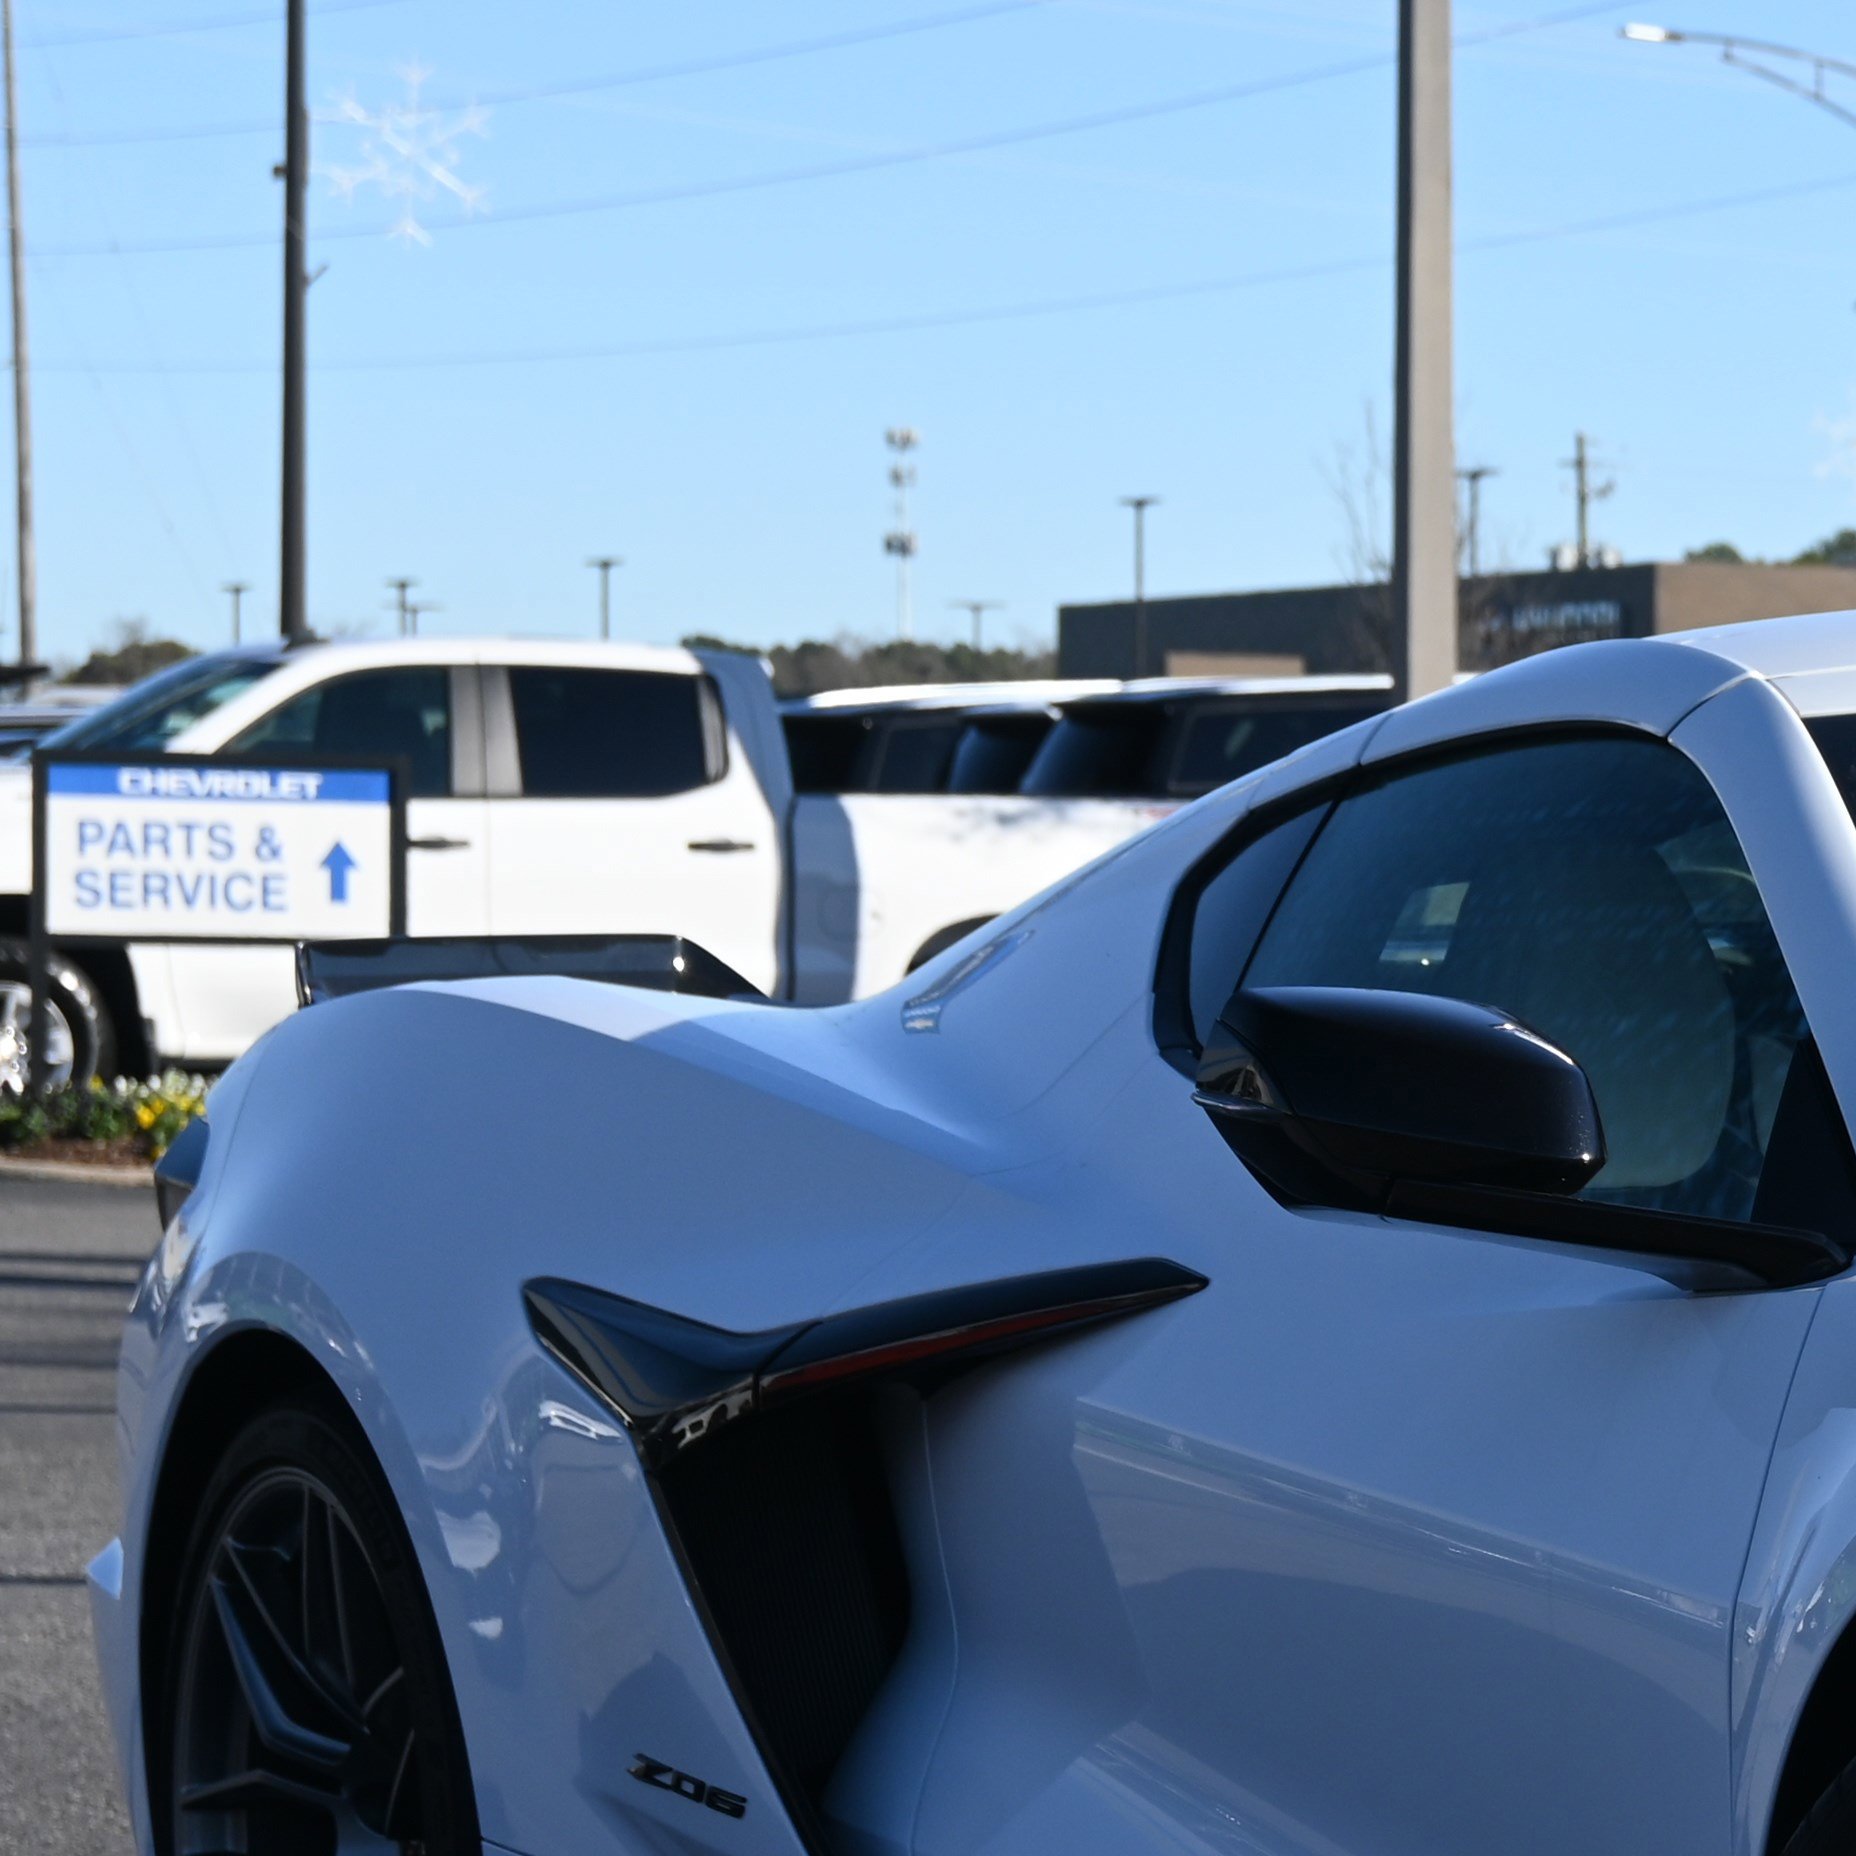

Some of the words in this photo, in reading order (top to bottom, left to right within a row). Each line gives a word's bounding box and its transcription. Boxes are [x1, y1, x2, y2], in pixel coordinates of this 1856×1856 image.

[118, 767, 322, 800] CHEVROLET
[627, 753, 748, 819] Z06
[77, 820, 235, 860] PARTS
[255, 826, 281, 861] &
[75, 870, 287, 911] SERVICE
